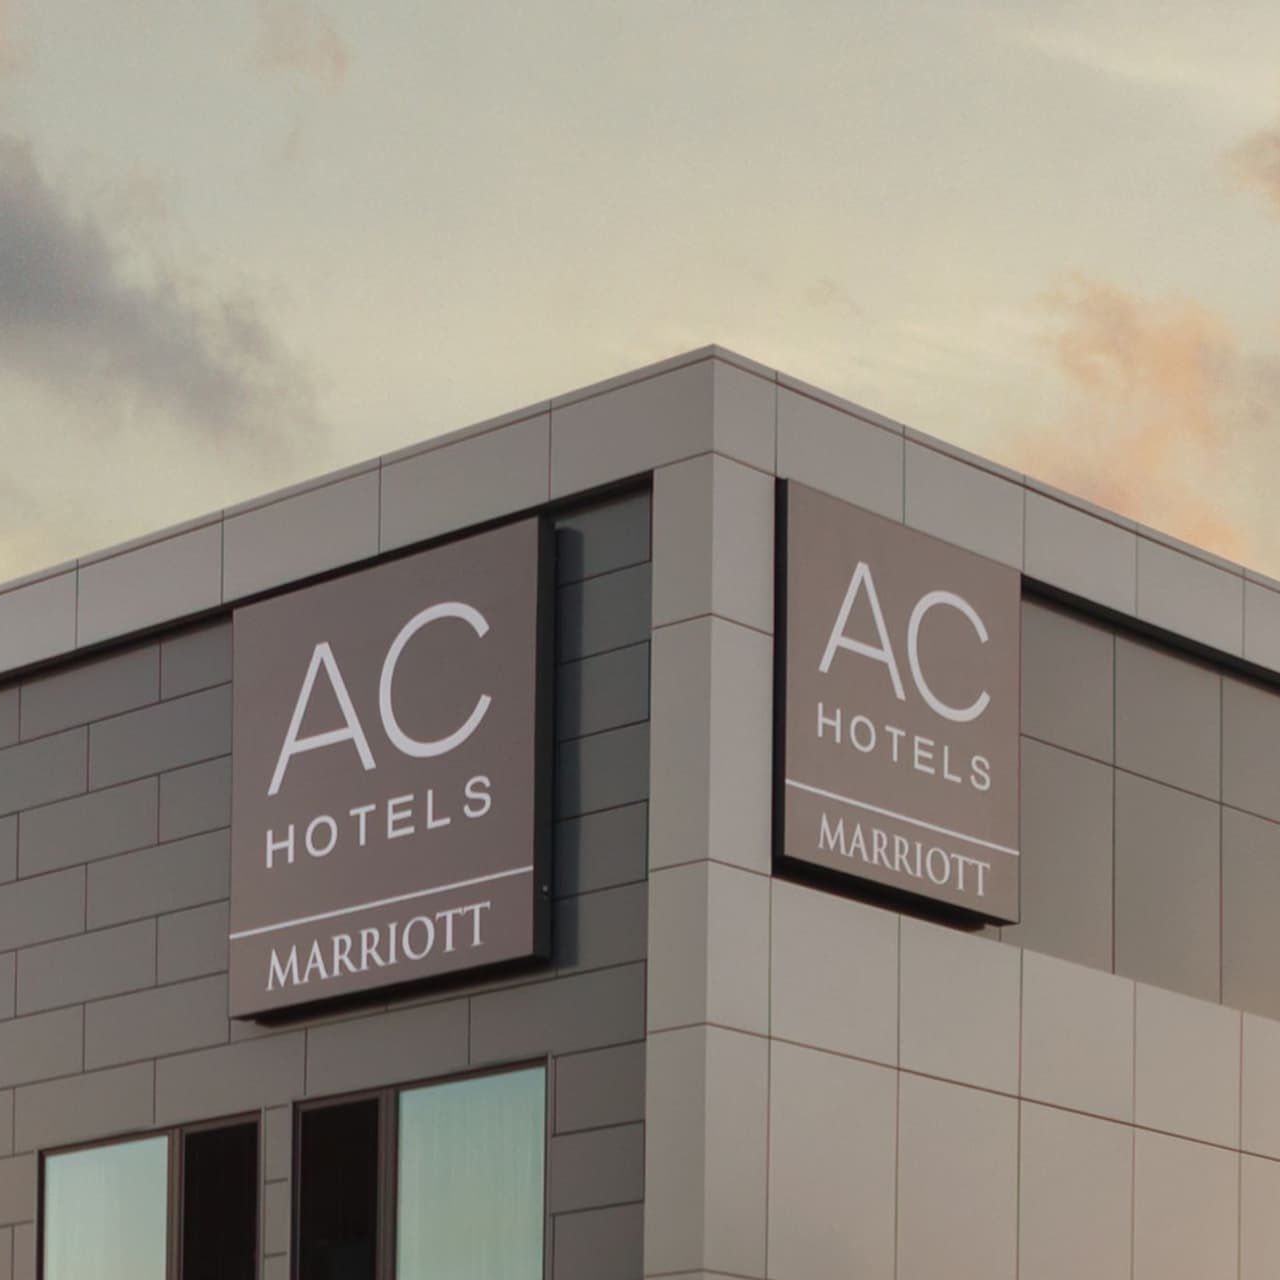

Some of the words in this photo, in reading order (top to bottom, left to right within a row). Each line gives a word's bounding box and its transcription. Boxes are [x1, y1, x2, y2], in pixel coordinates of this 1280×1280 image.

[818, 561, 991, 722] AC
[267, 601, 492, 796] AC
[817, 702, 991, 791] HOTELS
[265, 775, 492, 869] HOTELS
[818, 813, 991, 897] MARRIOTT
[265, 900, 492, 991] MARRIOTT
